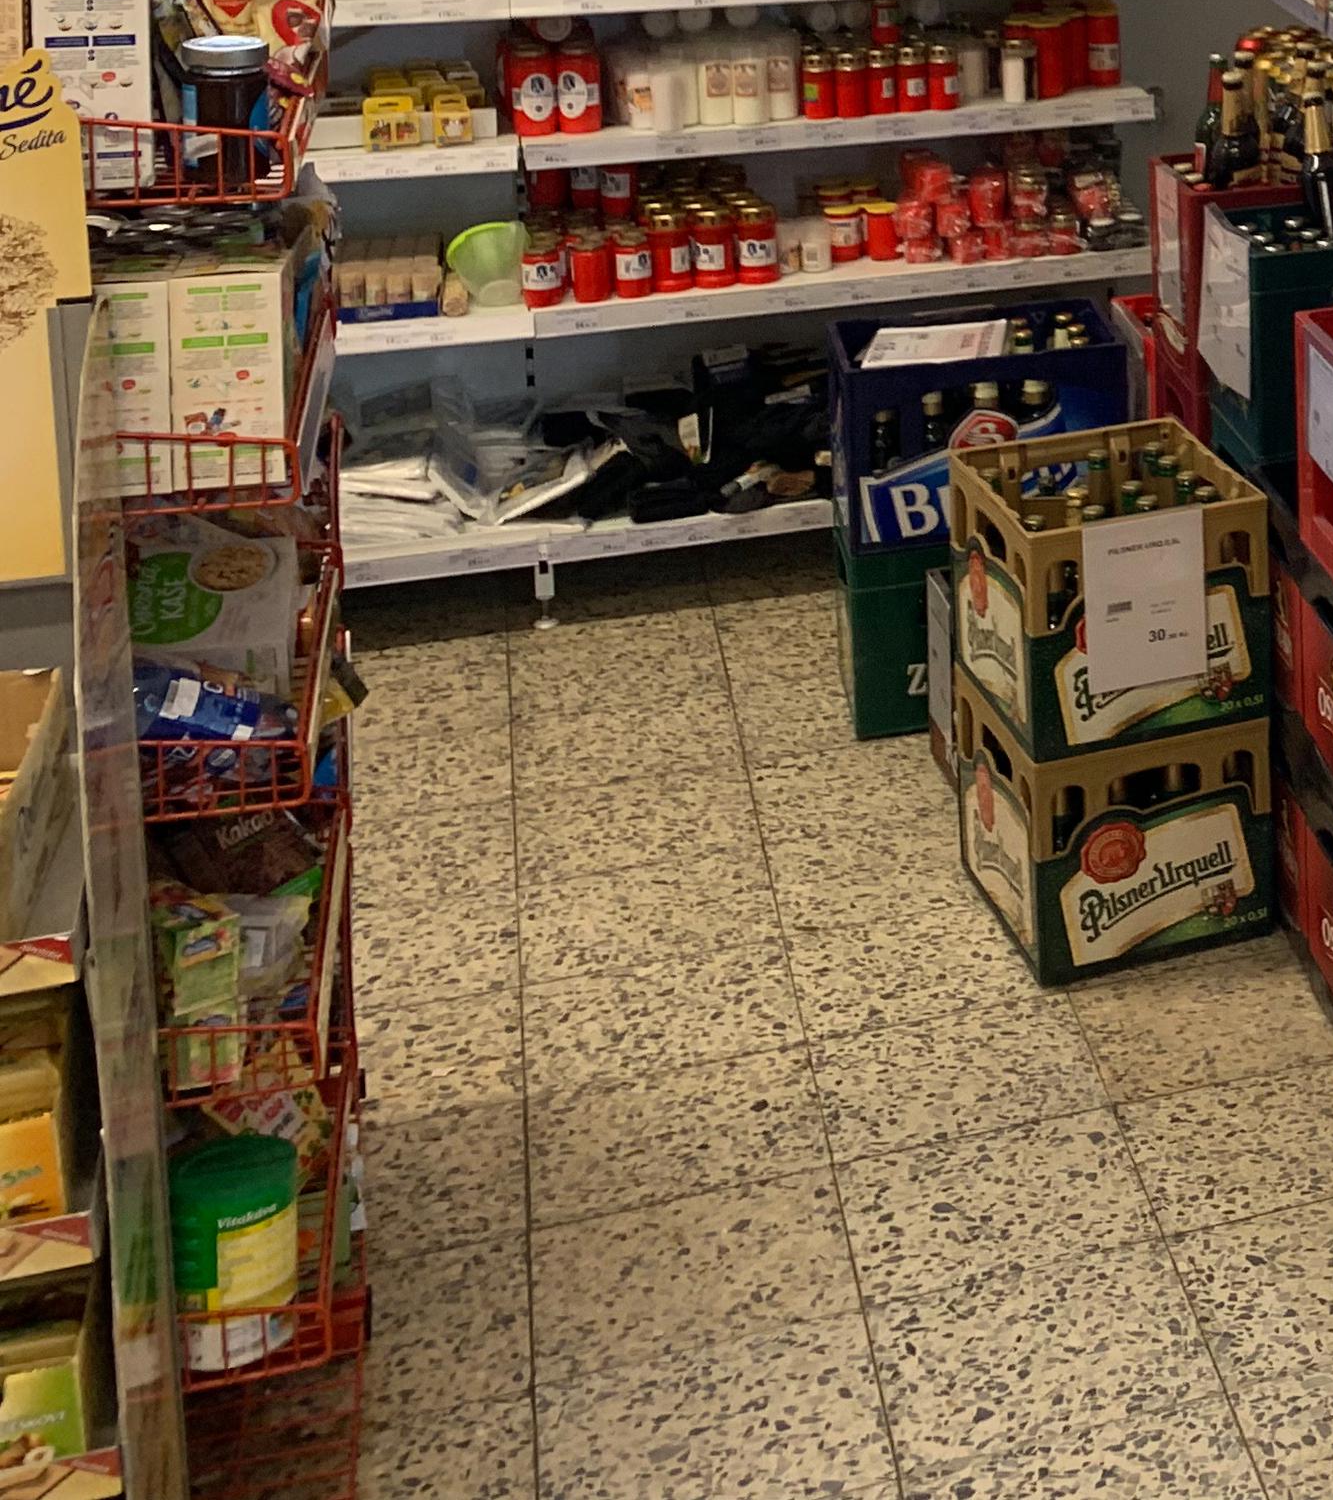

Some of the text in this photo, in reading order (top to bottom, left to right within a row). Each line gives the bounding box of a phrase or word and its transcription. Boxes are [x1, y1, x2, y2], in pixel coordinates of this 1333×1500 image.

[0, 129, 67, 161] Sedita
[215, 809, 275, 847] Kakao
[1079, 840, 1234, 943] Pilsner Urquell
